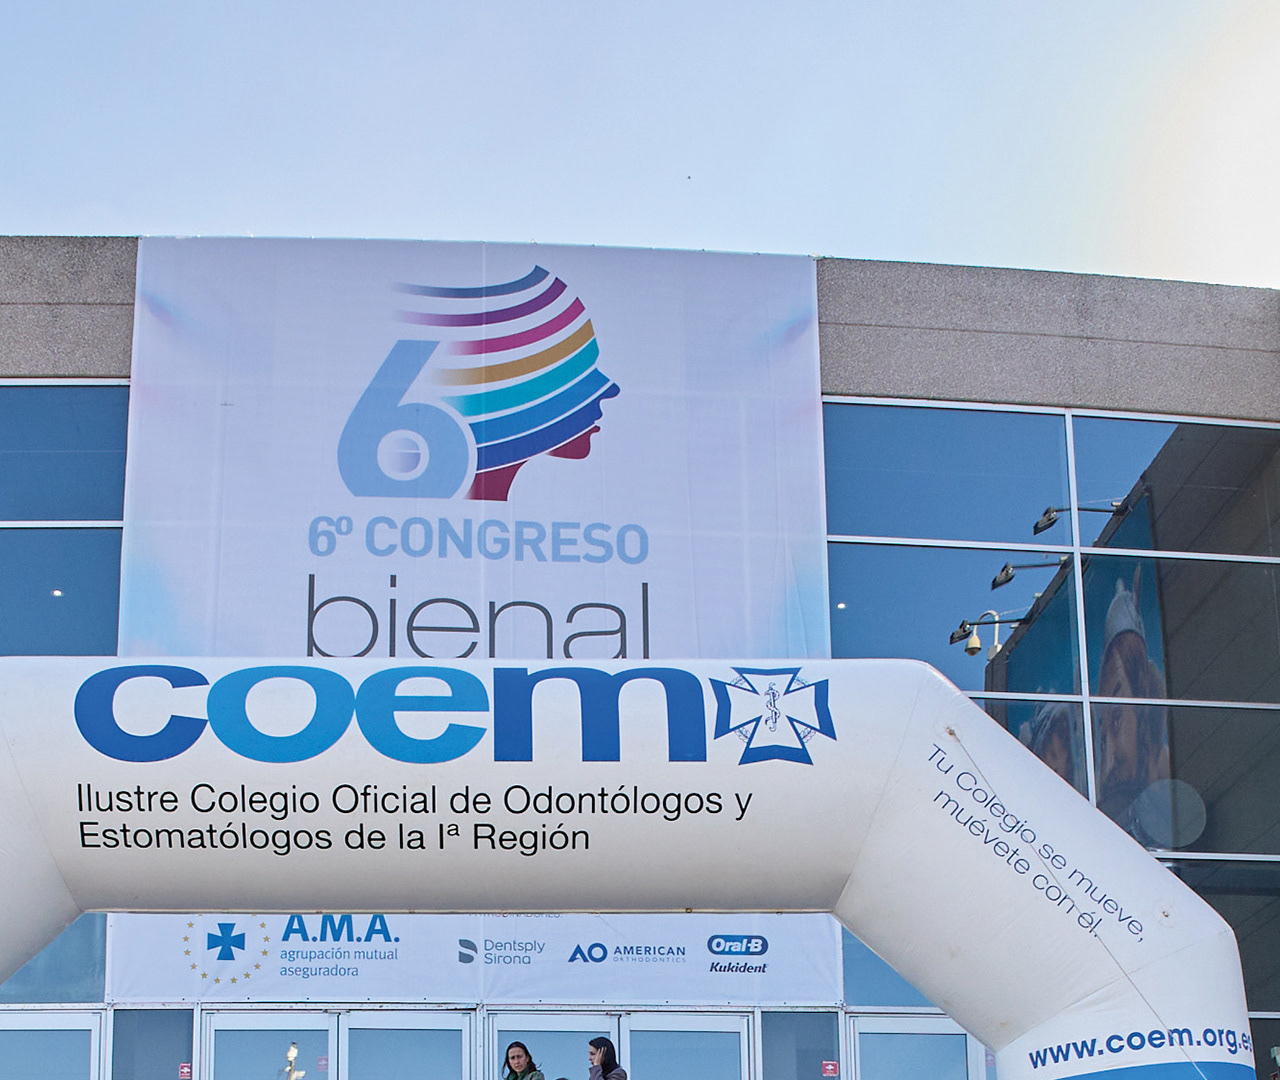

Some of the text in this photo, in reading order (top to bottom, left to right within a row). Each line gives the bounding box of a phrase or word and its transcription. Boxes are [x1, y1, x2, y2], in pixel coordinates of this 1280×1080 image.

[308, 515, 650, 565] 6º CONGRESO
[306, 574, 650, 659] bienal
[74, 664, 707, 764] coem
[76, 783, 753, 821] Ilustre Colegio Oficial de Odontólogos y
[79, 821, 333, 856] Estomatólogos
[344, 823, 386, 850] de
[399, 823, 426, 850] la
[473, 823, 590, 856] Región
[927, 743, 1144, 943] Tu Colegio se mueve,
[933, 790, 1102, 938] muévete con él.
[281, 914, 400, 943] A.M.A.
[280, 947, 398, 961] agrupación mutual
[483, 939, 546, 954] Dentsply
[484, 953, 531, 965] Sirona
[613, 945, 686, 956] AMERICAN
[710, 937, 763, 953] Oral-B
[280, 965, 359, 979] aseguradora
[709, 961, 768, 973] Kukident
